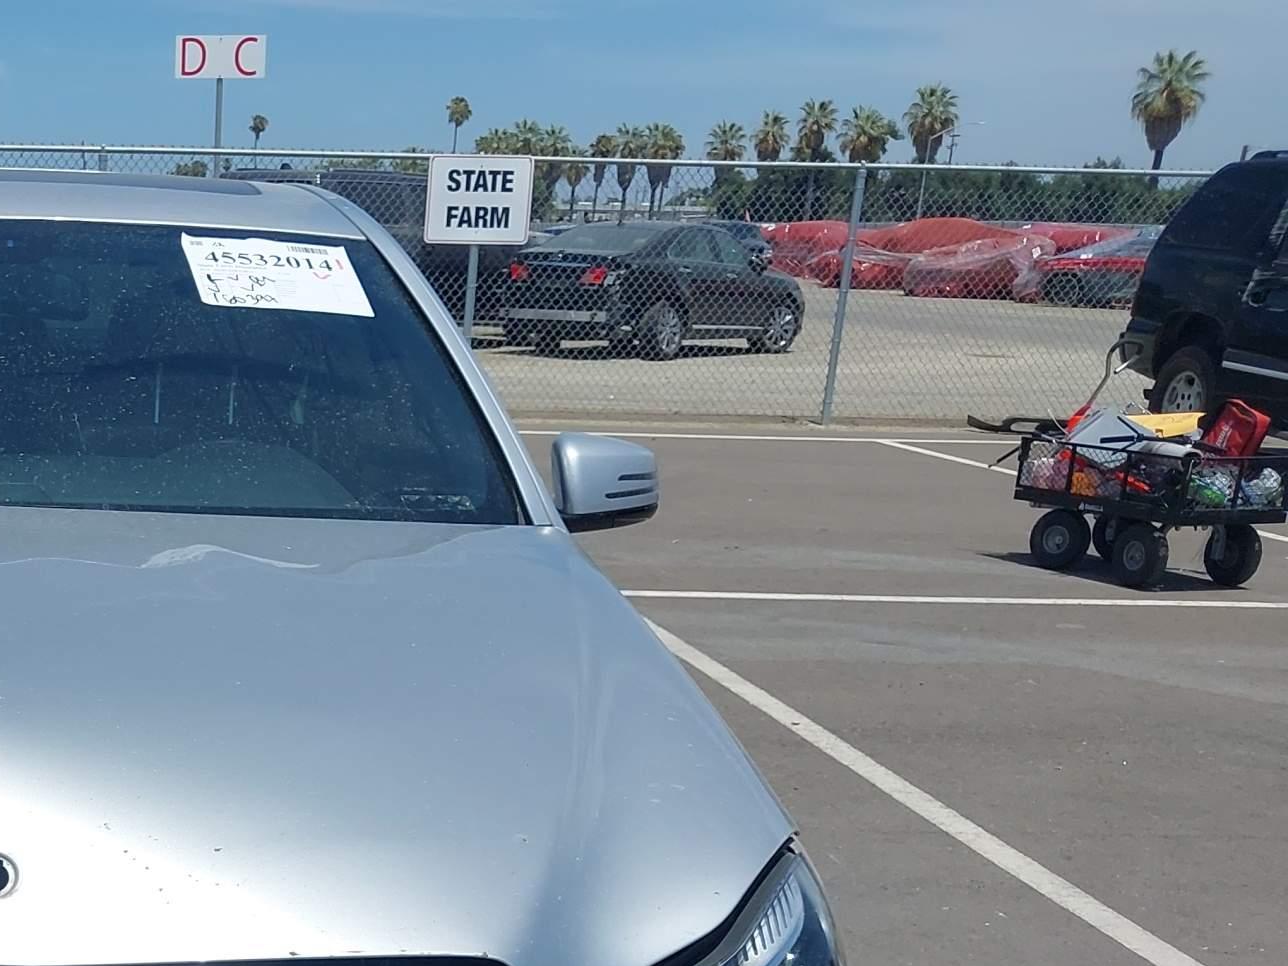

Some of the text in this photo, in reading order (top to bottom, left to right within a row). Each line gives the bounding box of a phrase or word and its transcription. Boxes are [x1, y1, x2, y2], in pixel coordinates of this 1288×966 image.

[181, 37, 259, 76] D C
[447, 169, 515, 193] STATE
[445, 206, 511, 229] FARM
[204, 250, 333, 272] 45532014
